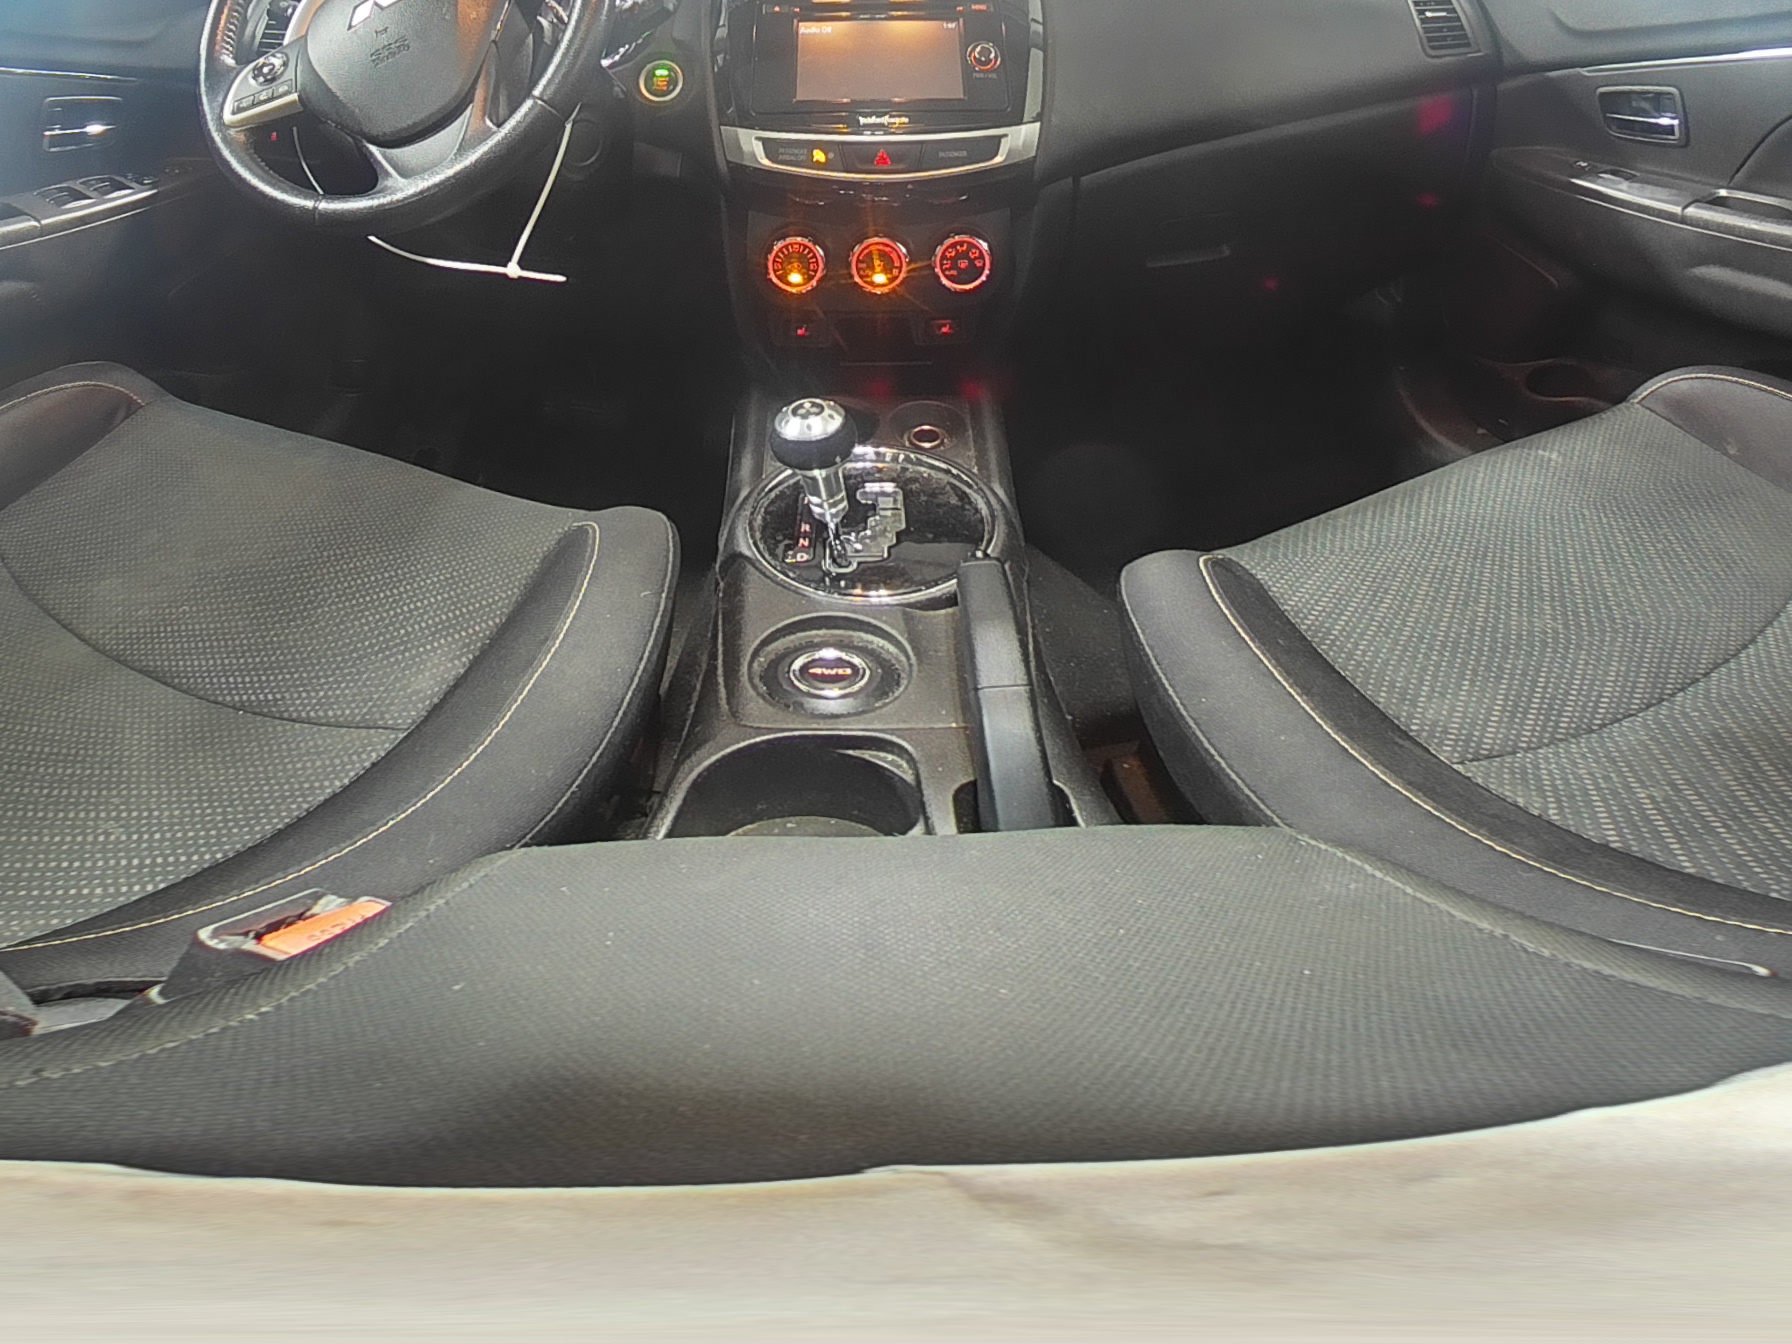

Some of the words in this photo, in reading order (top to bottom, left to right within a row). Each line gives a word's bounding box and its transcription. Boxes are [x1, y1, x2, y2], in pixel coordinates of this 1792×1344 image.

[800, 522, 811, 533] R
[798, 537, 810, 548] N
[796, 552, 809, 562] D
[808, 667, 853, 675] 4WD
